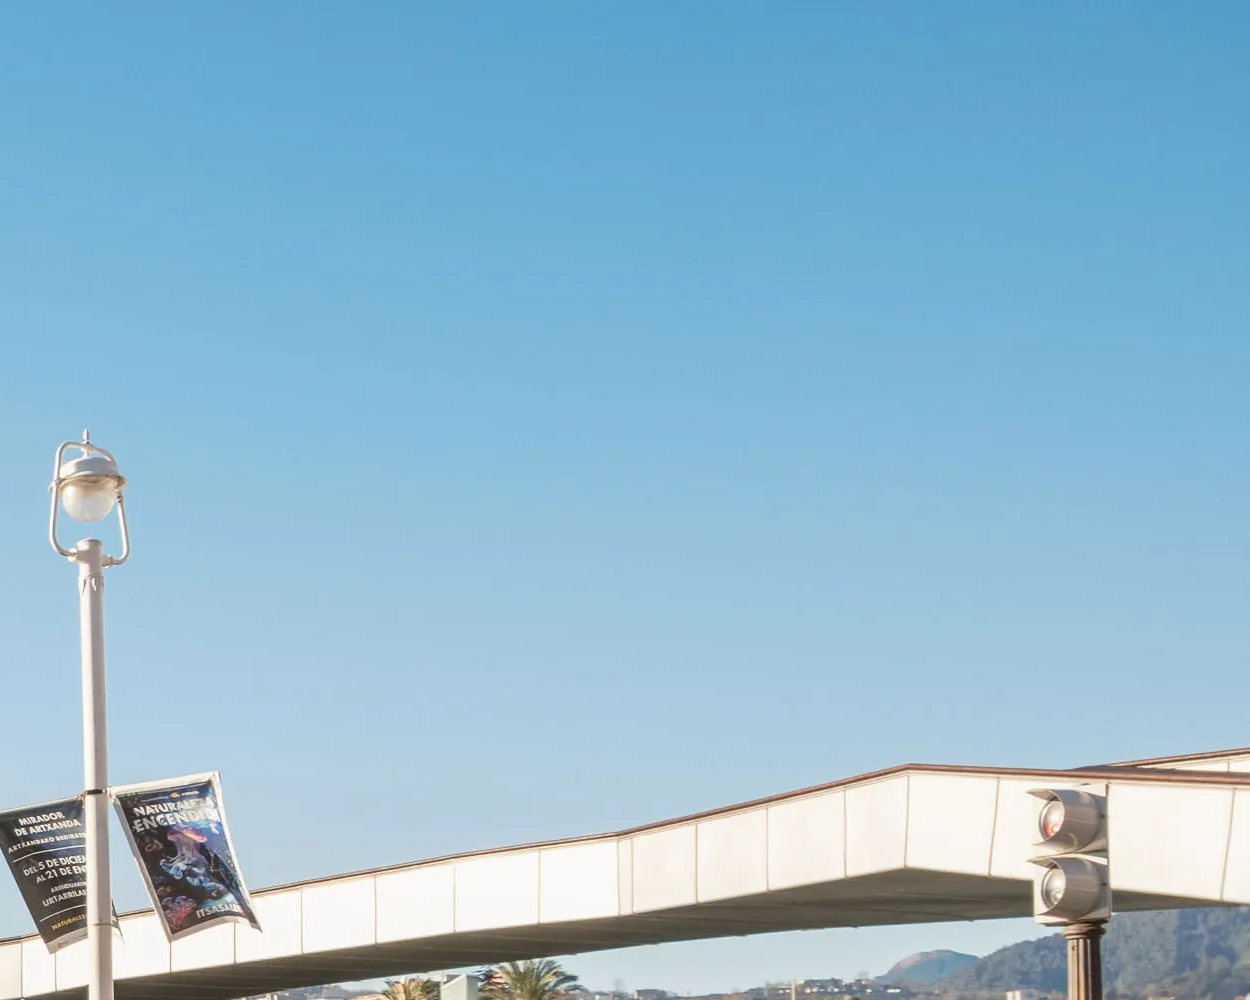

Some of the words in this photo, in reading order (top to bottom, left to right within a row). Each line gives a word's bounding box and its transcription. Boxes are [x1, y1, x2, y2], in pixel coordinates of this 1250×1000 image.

[18, 811, 65, 826] MIRADOR
[14, 827, 28, 837] DE
[29, 819, 82, 834] ARTXANDA
[8, 837, 55, 854] ARTXANDAKO
[23, 866, 39, 876] DEL
[38, 861, 46, 871] 5
[45, 859, 60, 868] DE
[36, 874, 46, 884] AL
[45, 869, 58, 879] 21
[59, 867, 72, 876] DE
[72, 864, 87, 874] EN
[51, 913, 87, 931] NATURALEZ
